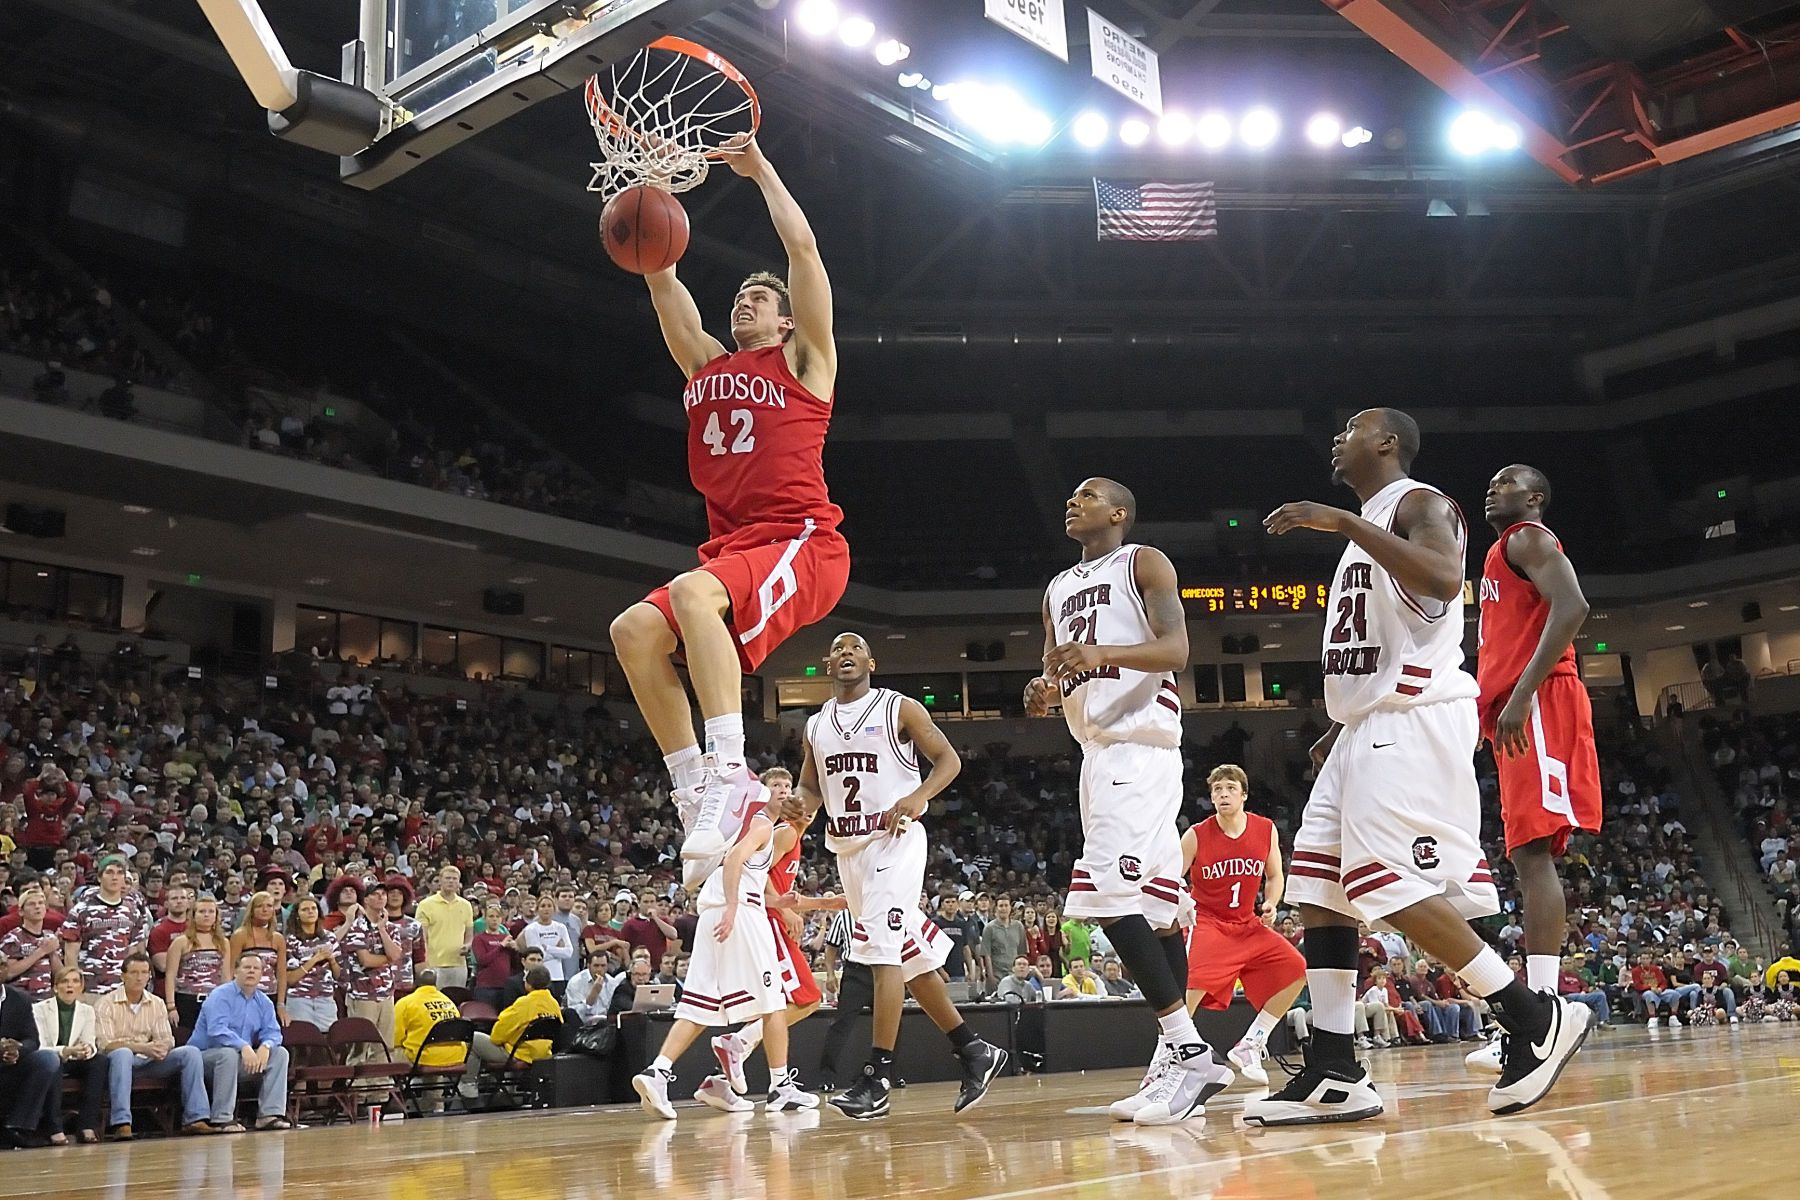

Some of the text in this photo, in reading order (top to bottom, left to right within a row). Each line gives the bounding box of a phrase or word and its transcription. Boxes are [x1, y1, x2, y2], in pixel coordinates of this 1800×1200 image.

[703, 408, 755, 456] 42
[1181, 588, 1225, 599] GAMECOCKS
[1250, 586, 1259, 599] 3
[1271, 584, 1307, 600] 16:48
[1317, 584, 1326, 597] 6
[1059, 584, 1111, 625] SOUTH
[1208, 599, 1224, 611] 31
[1249, 599, 1258, 610] 4
[1291, 598, 1300, 609] 2
[1316, 597, 1326, 608] 4
[1329, 592, 1367, 643] 24
[1068, 609, 1097, 645] 21
[825, 752, 878, 777] SOUTH
[842, 776, 861, 812] 2
[1229, 881, 1241, 908] 1
